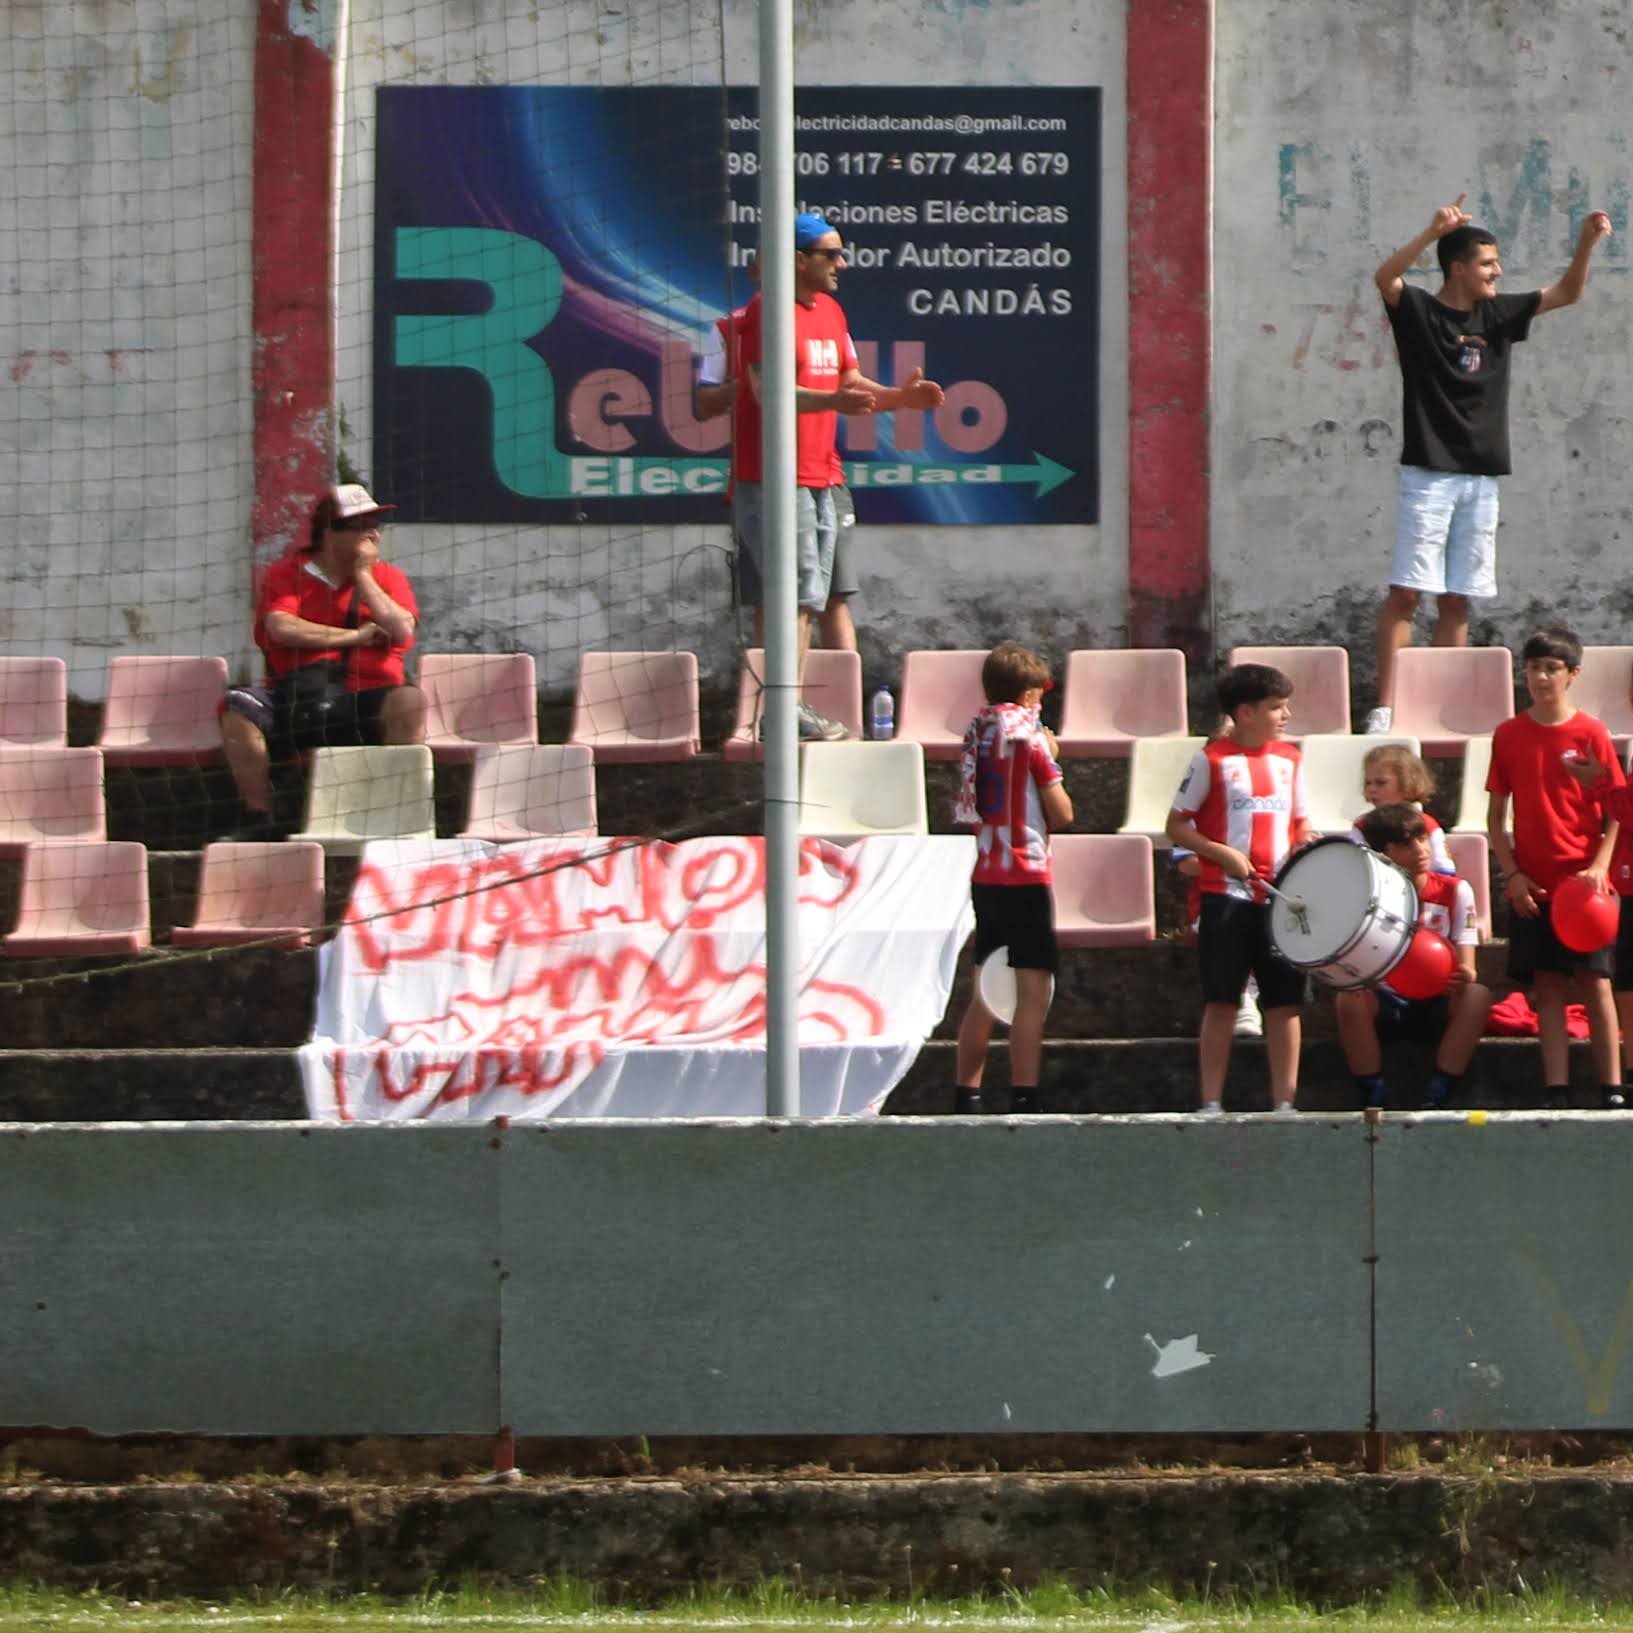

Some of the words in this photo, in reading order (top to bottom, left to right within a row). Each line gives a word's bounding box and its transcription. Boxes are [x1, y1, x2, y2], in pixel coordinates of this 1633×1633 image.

[727, 152, 762, 175] 98
[794, 152, 830, 175] 06
[839, 152, 883, 175] 117
[908, 151, 957, 175] 677
[964, 152, 1013, 175] 424
[1021, 152, 1070, 175] 679
[926, 200, 1069, 224] Eléctricas
[898, 241, 1072, 268] Autorizado
[910, 283, 1073, 315] CANDÁS
[395, 226, 1009, 499] Rebllo
[570, 455, 1001, 497] Elecidad
